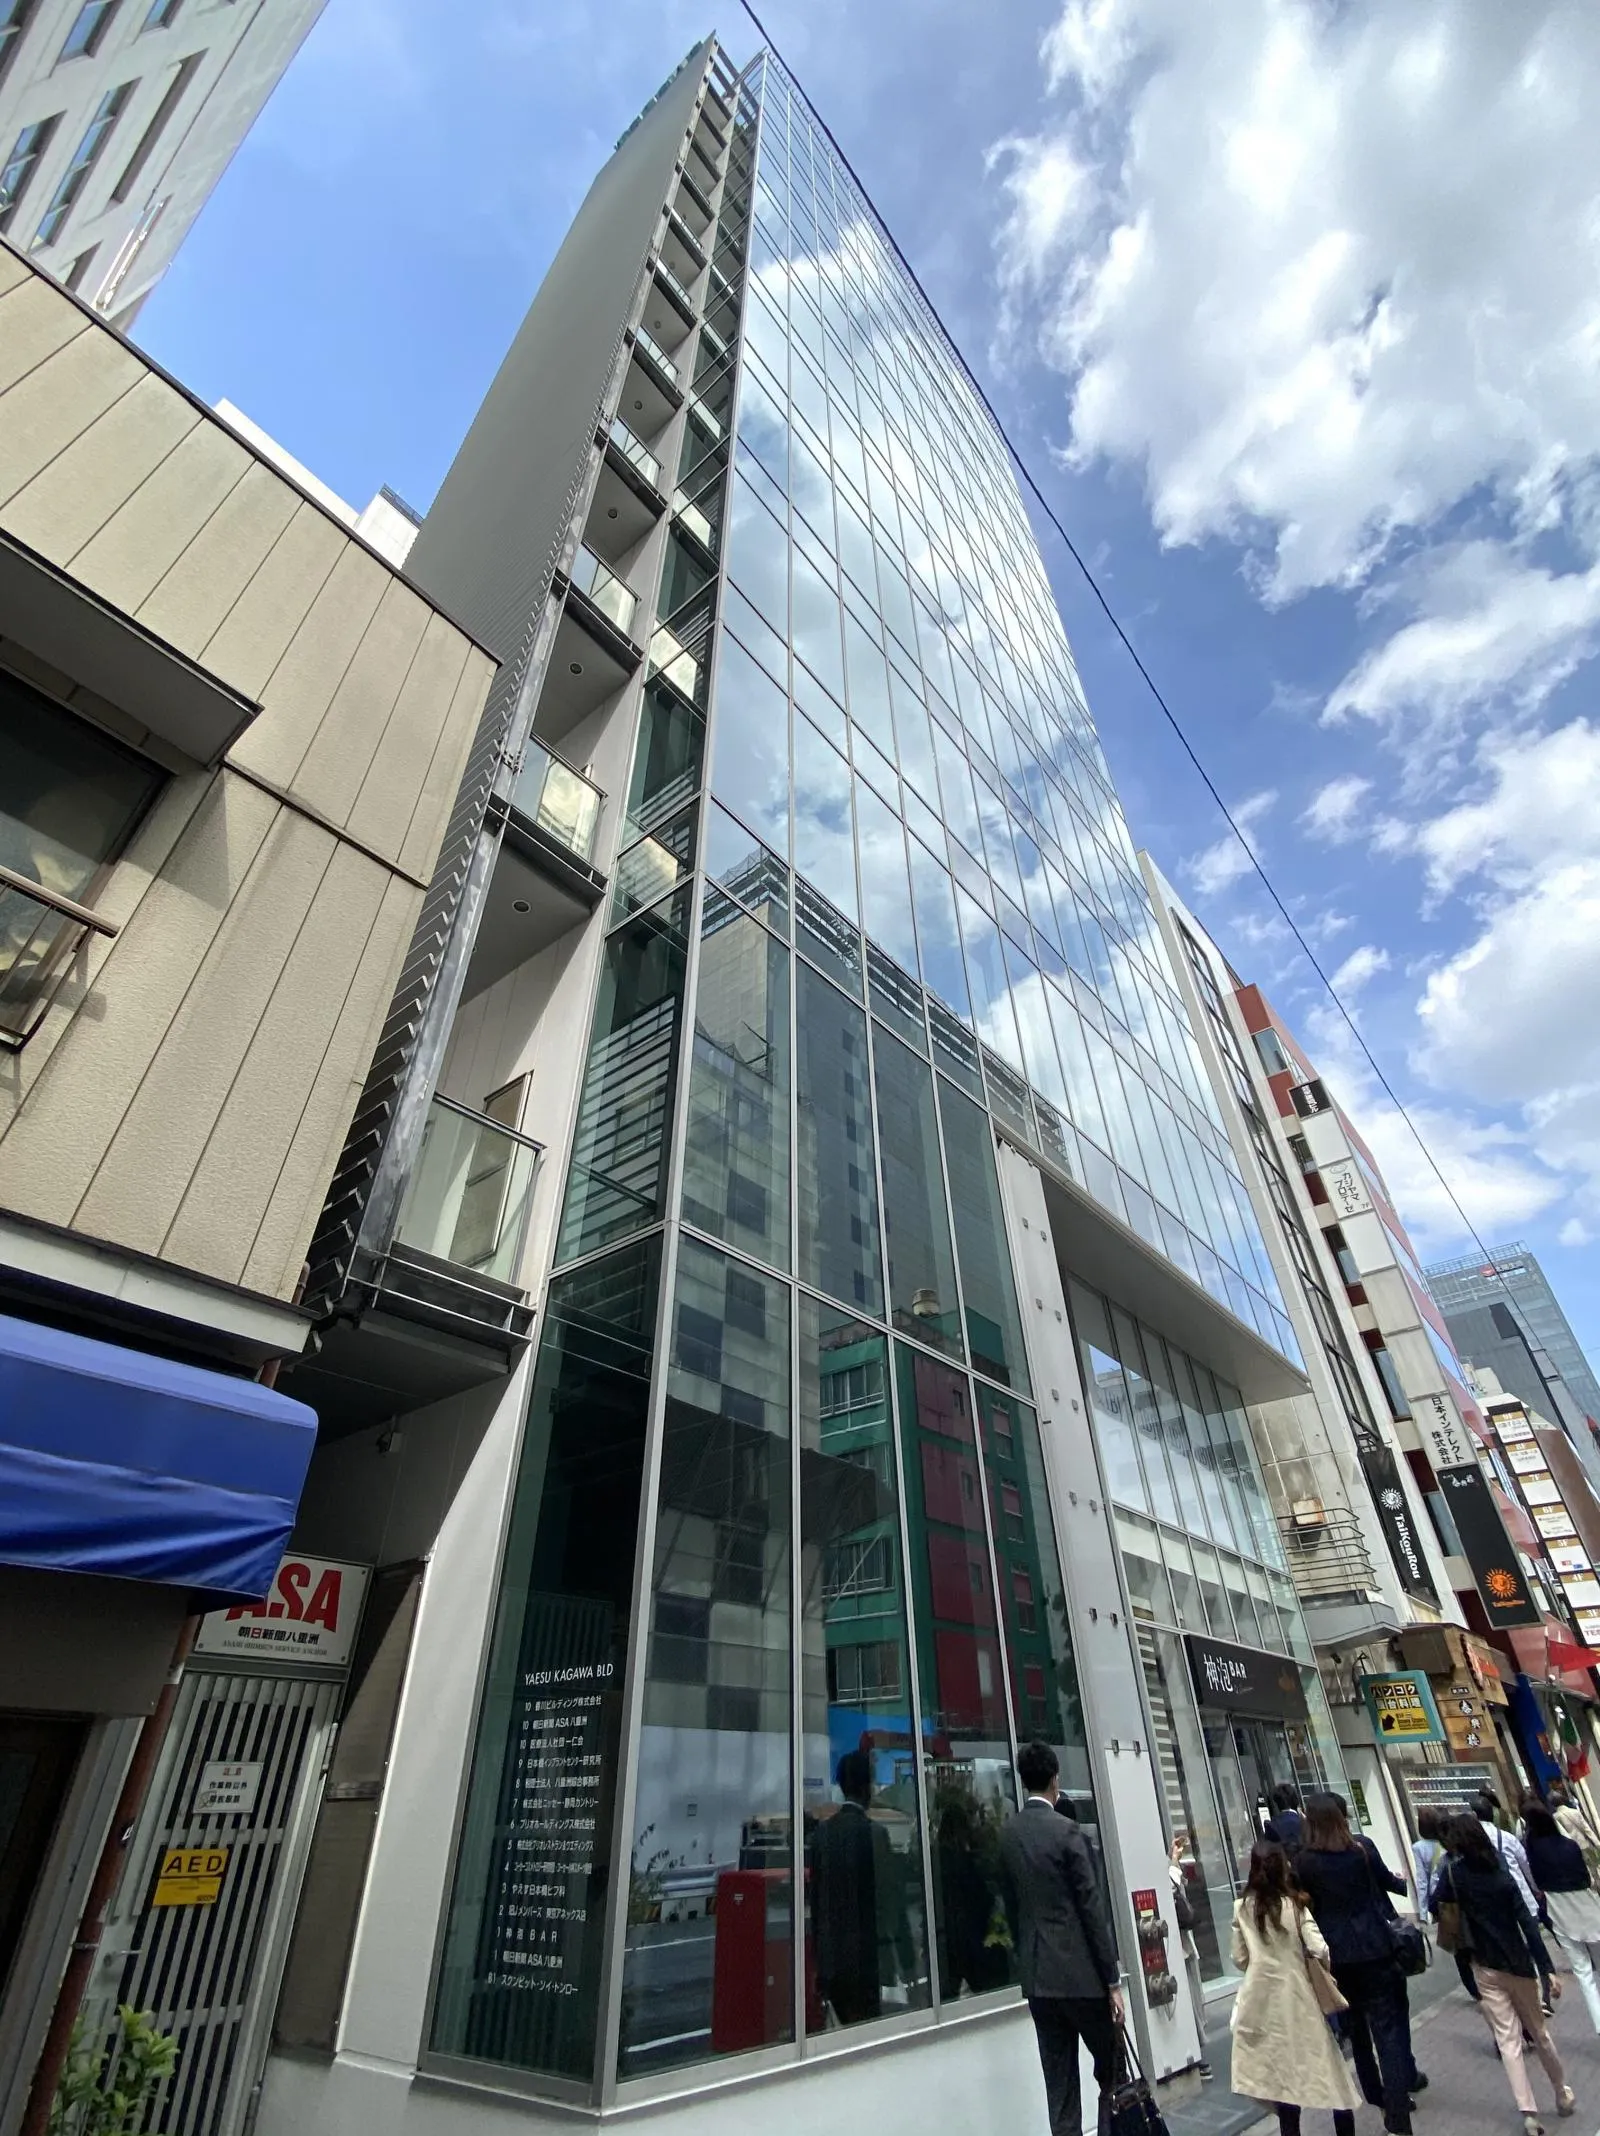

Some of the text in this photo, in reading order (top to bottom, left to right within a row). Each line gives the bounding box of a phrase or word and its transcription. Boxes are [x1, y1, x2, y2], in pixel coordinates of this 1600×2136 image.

[1432, 1396, 1465, 1463] 日本インテレクト
[1431, 1431, 1454, 1465] 株式会社
[238, 1625, 320, 1645] 朝日新聞八重洲
[525, 1663, 614, 1686] YAESU KAGAWA BLD
[1203, 1653, 1247, 1692] 神泡 BAR
[518, 1759, 524, 1769] 9
[513, 1798, 518, 1808] 7
[510, 1820, 515, 1829] 6
[507, 1839, 513, 1850] 5
[164, 1856, 222, 1873] AED
[504, 1861, 510, 1871] 4
[499, 1904, 504, 1916] 2
